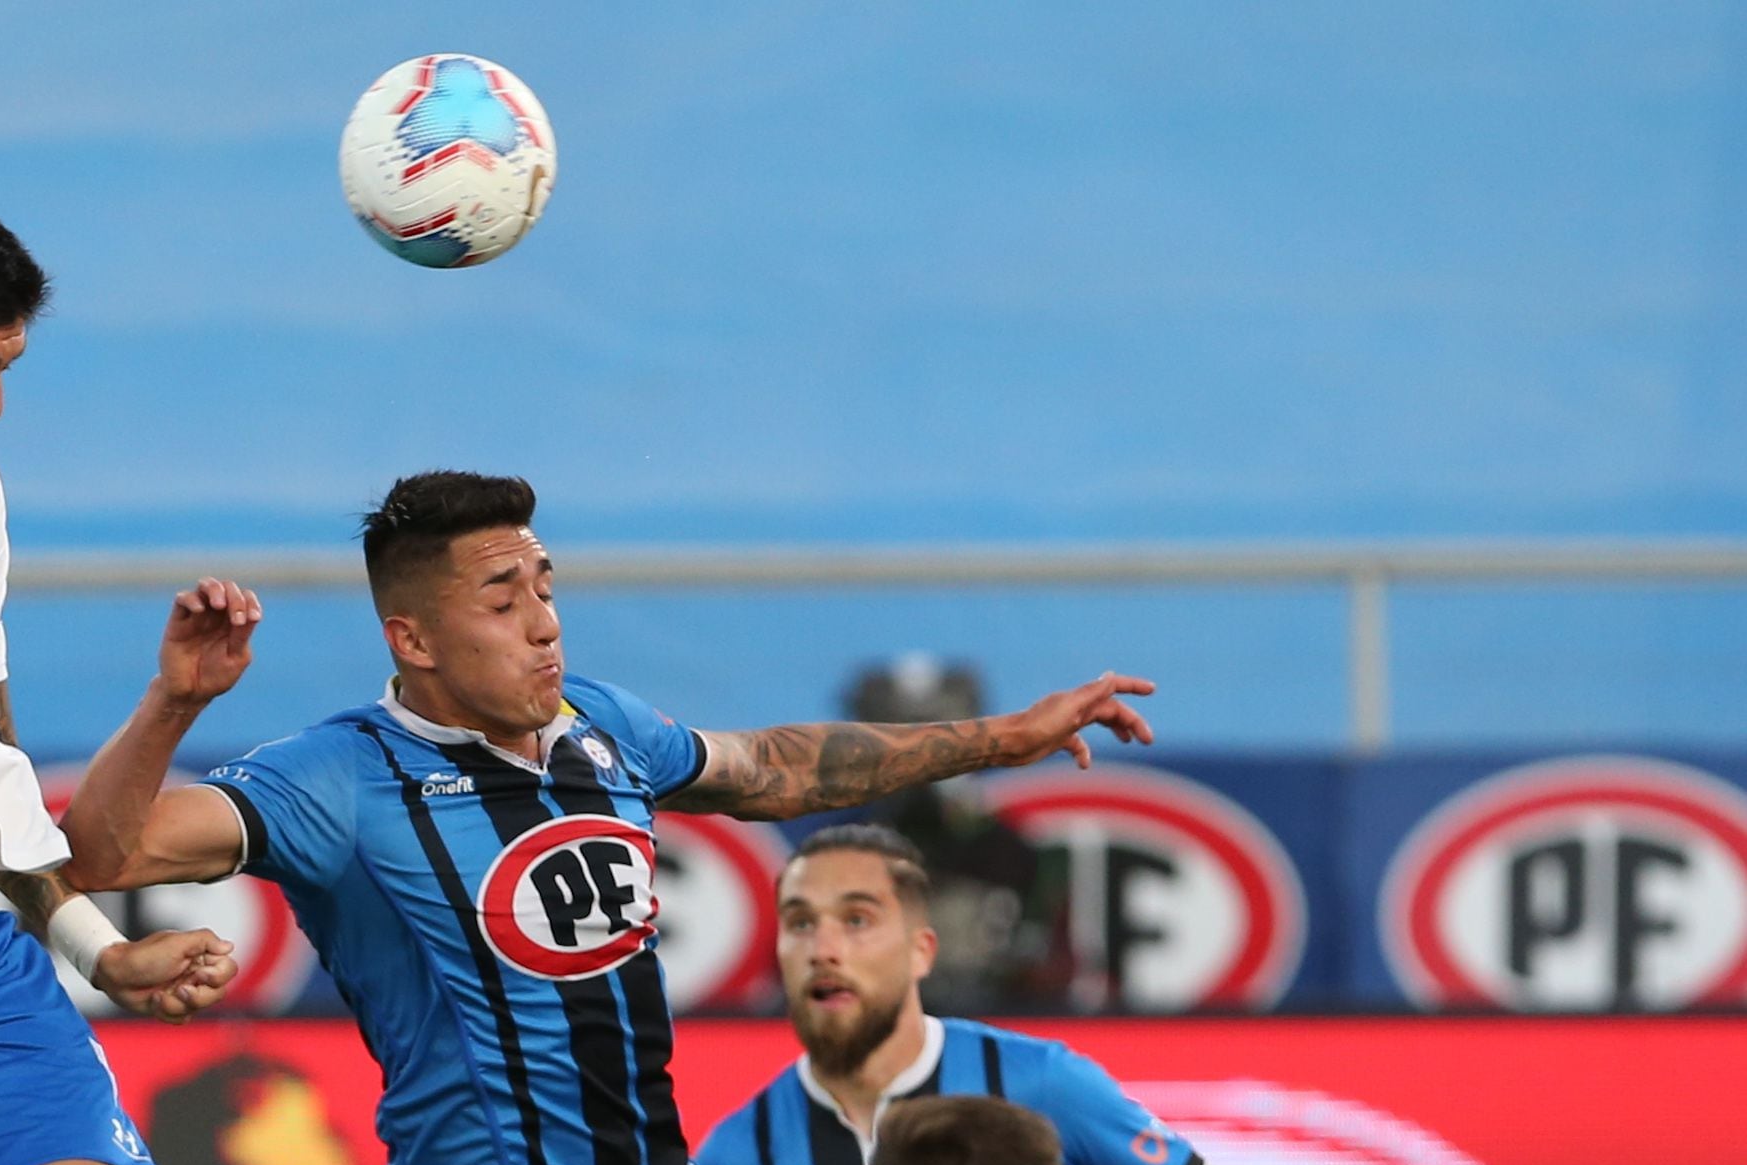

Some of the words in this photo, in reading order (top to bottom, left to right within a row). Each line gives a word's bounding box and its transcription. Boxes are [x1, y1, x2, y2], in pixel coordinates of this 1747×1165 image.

[421, 775, 475, 796] Onefit
[529, 841, 636, 947] PF
[1510, 838, 1689, 1012] PF
